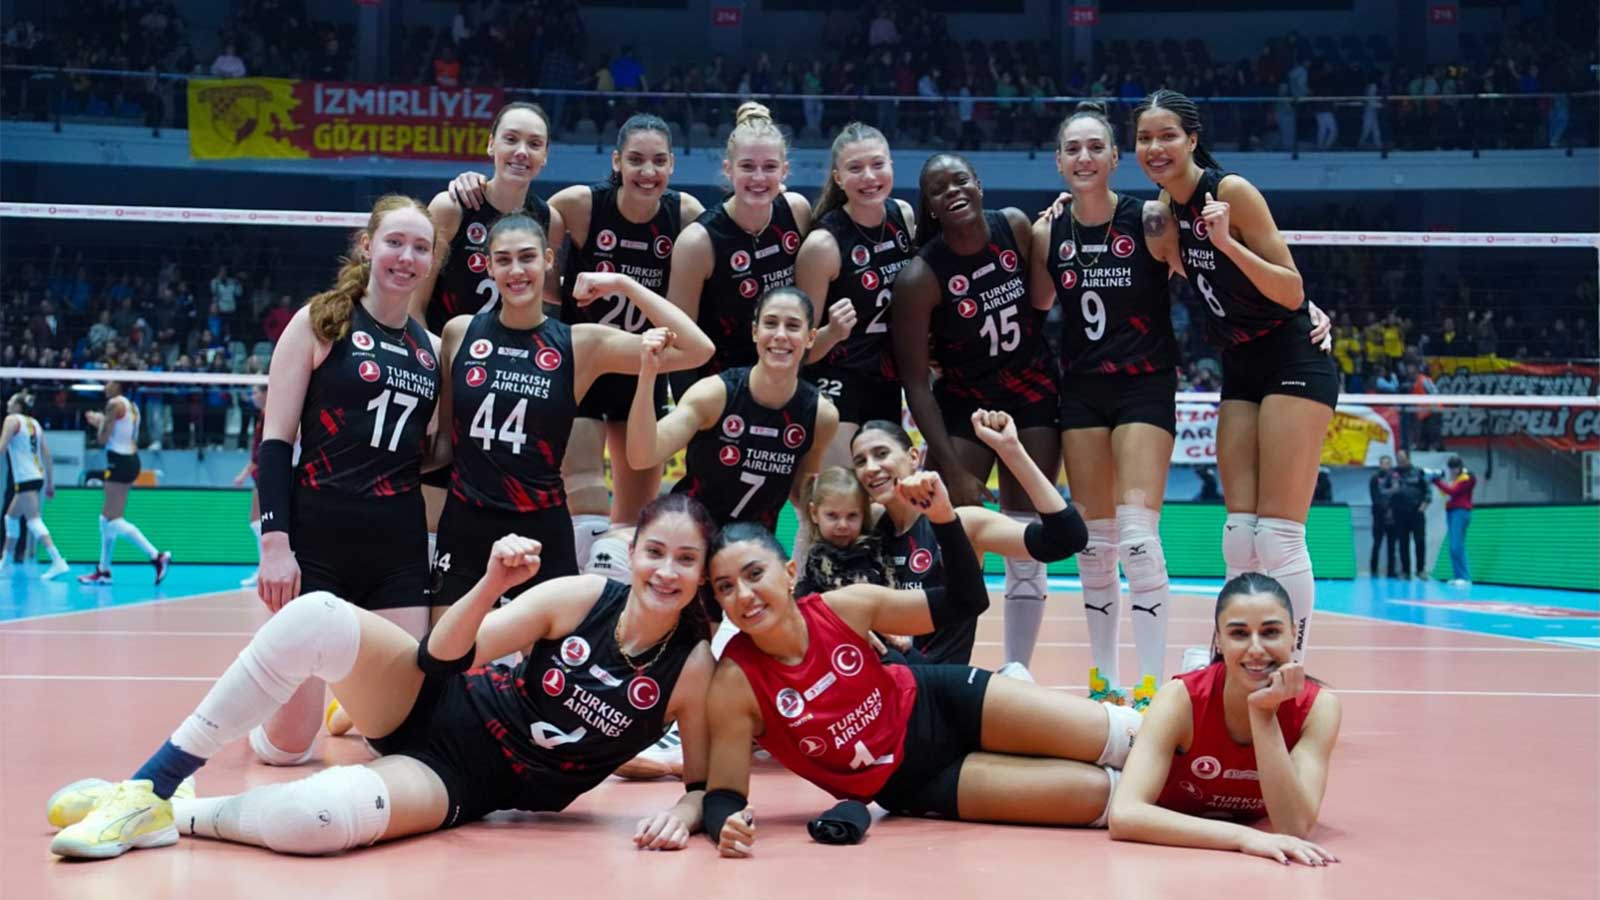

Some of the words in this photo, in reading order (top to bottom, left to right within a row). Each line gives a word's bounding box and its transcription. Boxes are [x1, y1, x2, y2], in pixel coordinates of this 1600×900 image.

[1081, 278, 1132, 288] AIRLINES
[1082, 267, 1131, 278] TURKISH
[980, 277, 1022, 301] TURKISH
[983, 287, 1025, 312] AIRLINES
[1197, 273, 1225, 317] 8
[598, 293, 646, 332] 20
[866, 288, 892, 333] 2
[1081, 290, 1106, 341] 9
[979, 304, 1021, 357] 15
[386, 365, 435, 390] TURKISH
[386, 376, 434, 400] AIRLINES
[490, 381, 549, 399] AIRLINES
[495, 370, 551, 388] TURKISH
[817, 377, 843, 396] 22
[367, 389, 418, 452] 17
[469, 392, 528, 454] 44
[742, 460, 793, 474] AIRLINES
[746, 448, 795, 464] TURKISH
[730, 471, 766, 518] 7
[563, 698, 624, 738] AIRLINES
[573, 684, 633, 728] TURKISH
[827, 688, 882, 736] TURKISH
